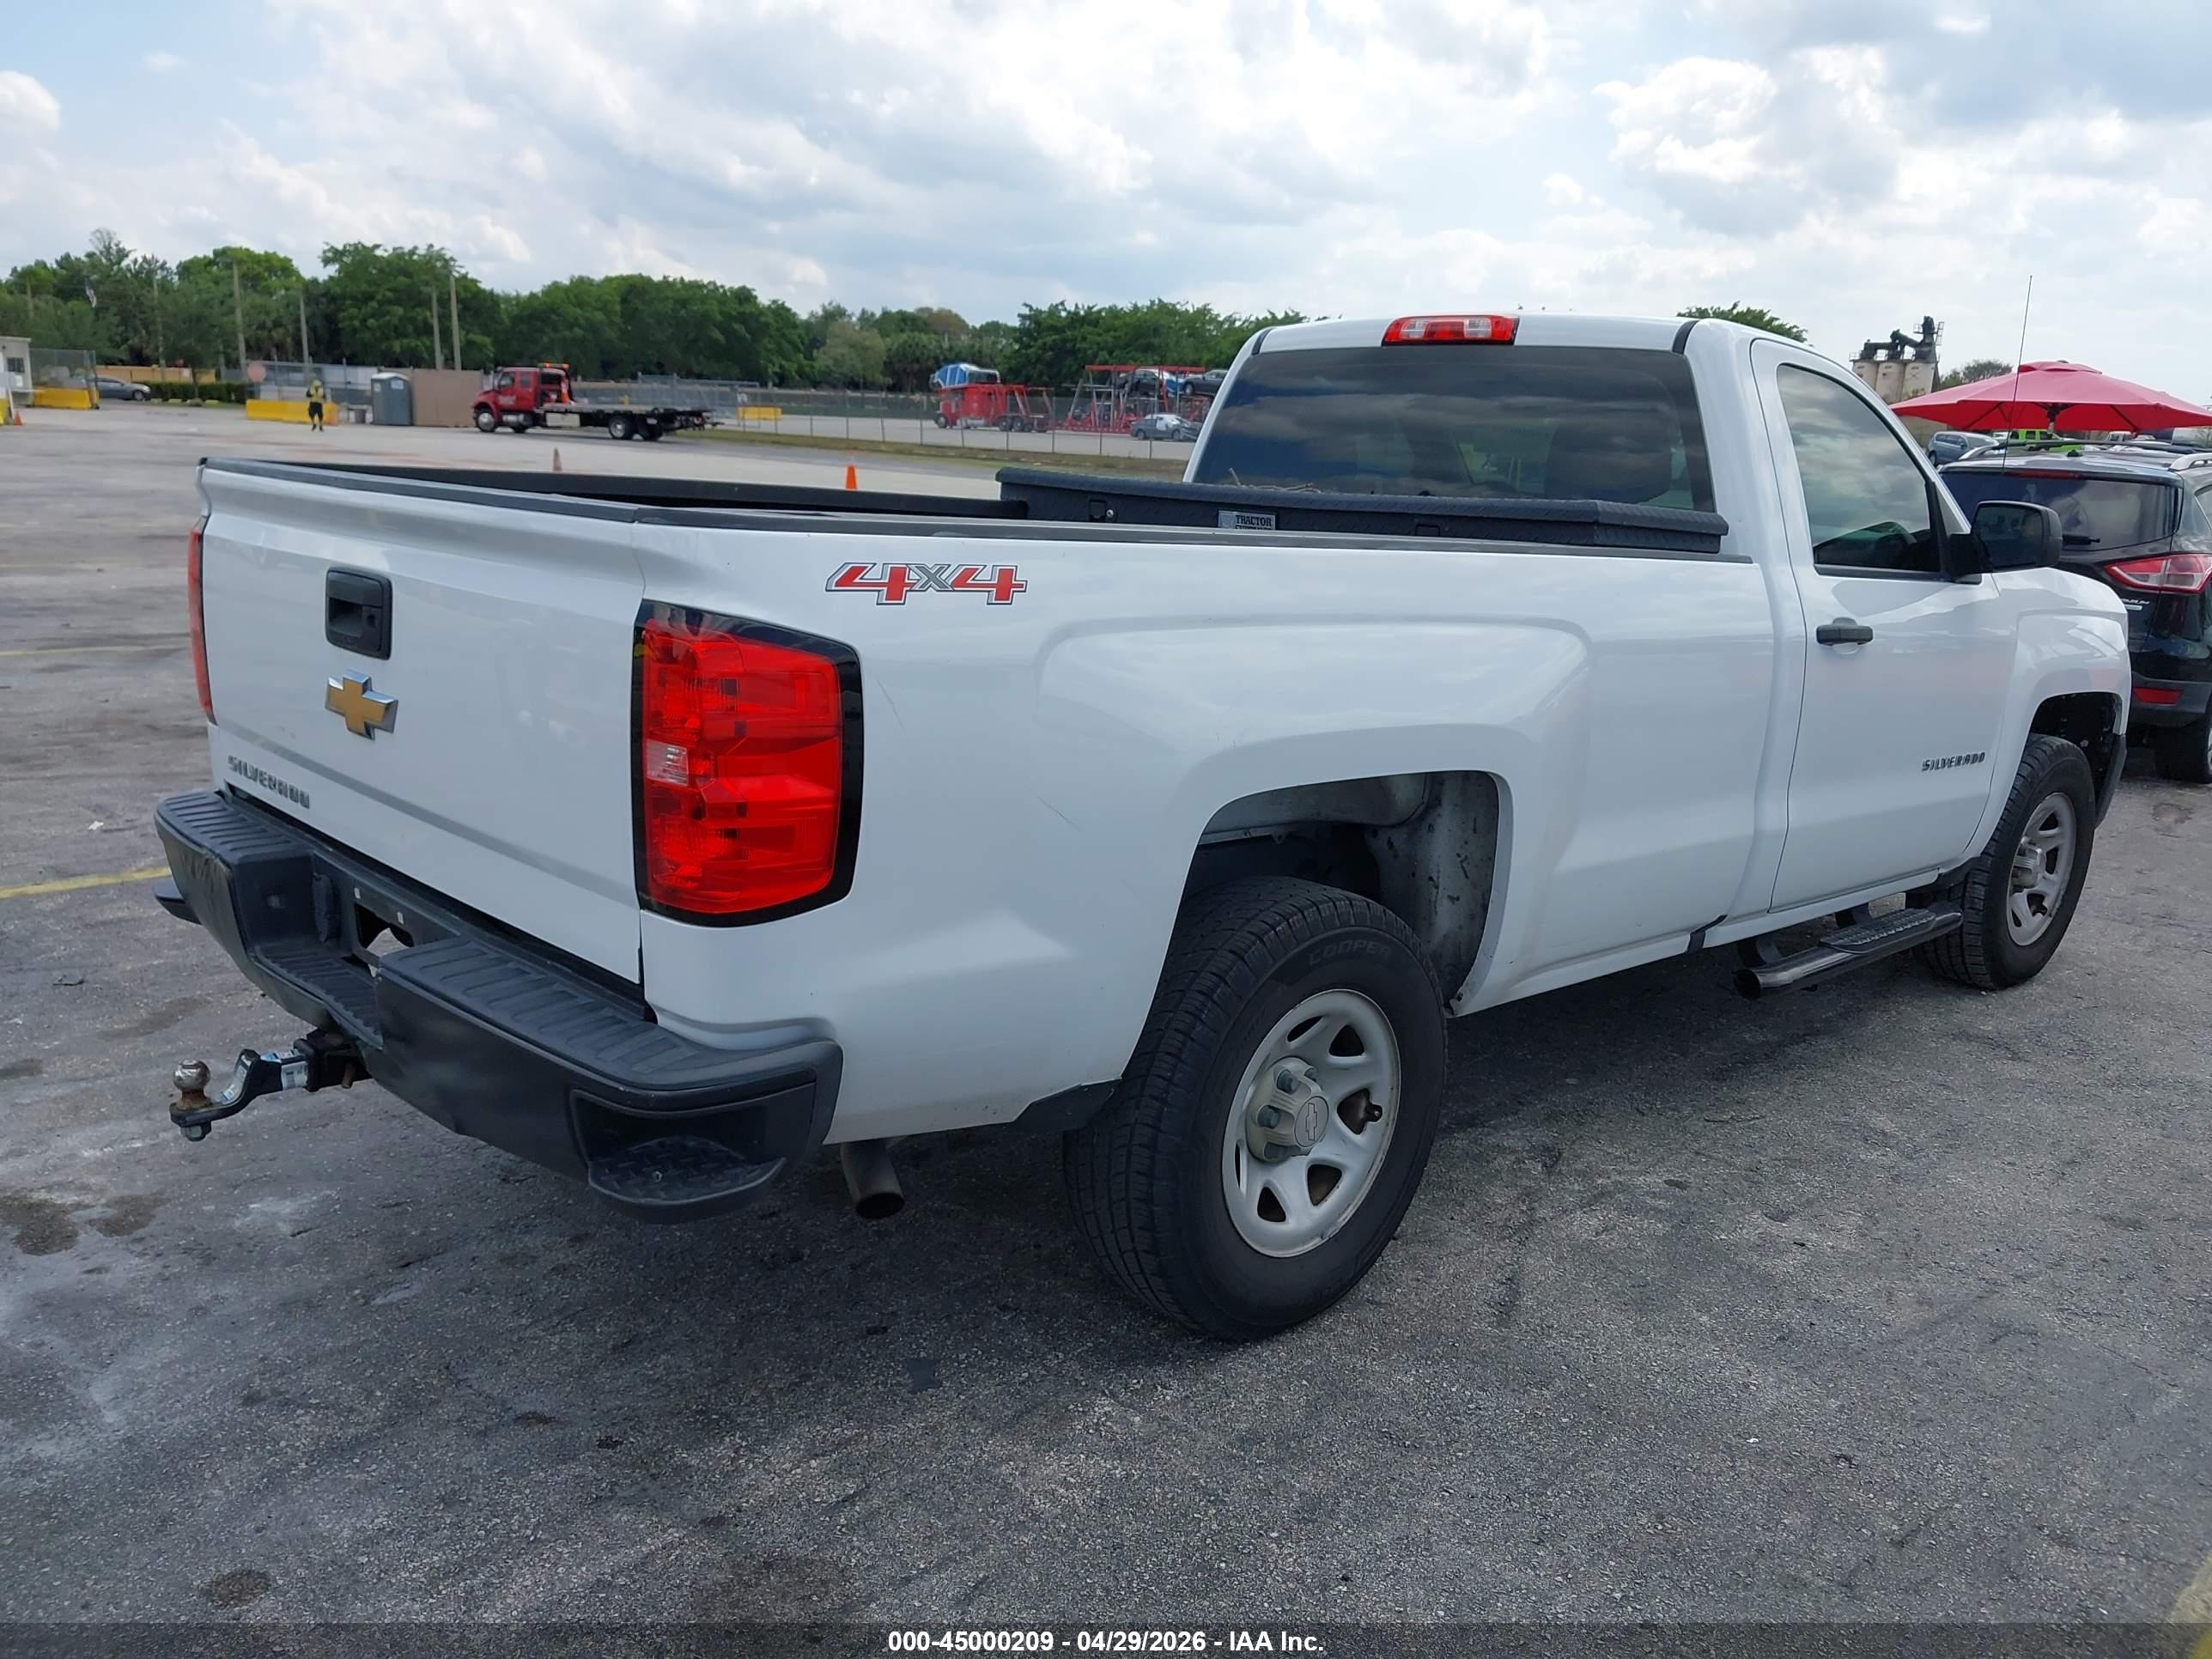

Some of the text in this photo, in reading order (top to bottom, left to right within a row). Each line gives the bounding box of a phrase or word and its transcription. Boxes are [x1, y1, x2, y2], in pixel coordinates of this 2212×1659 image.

[1235, 514, 1272, 526] TRACTOR
[1922, 751, 1985, 772] SILVERADO
[228, 755, 310, 808] SILVERADO
[1309, 939, 1391, 965] COOPER
